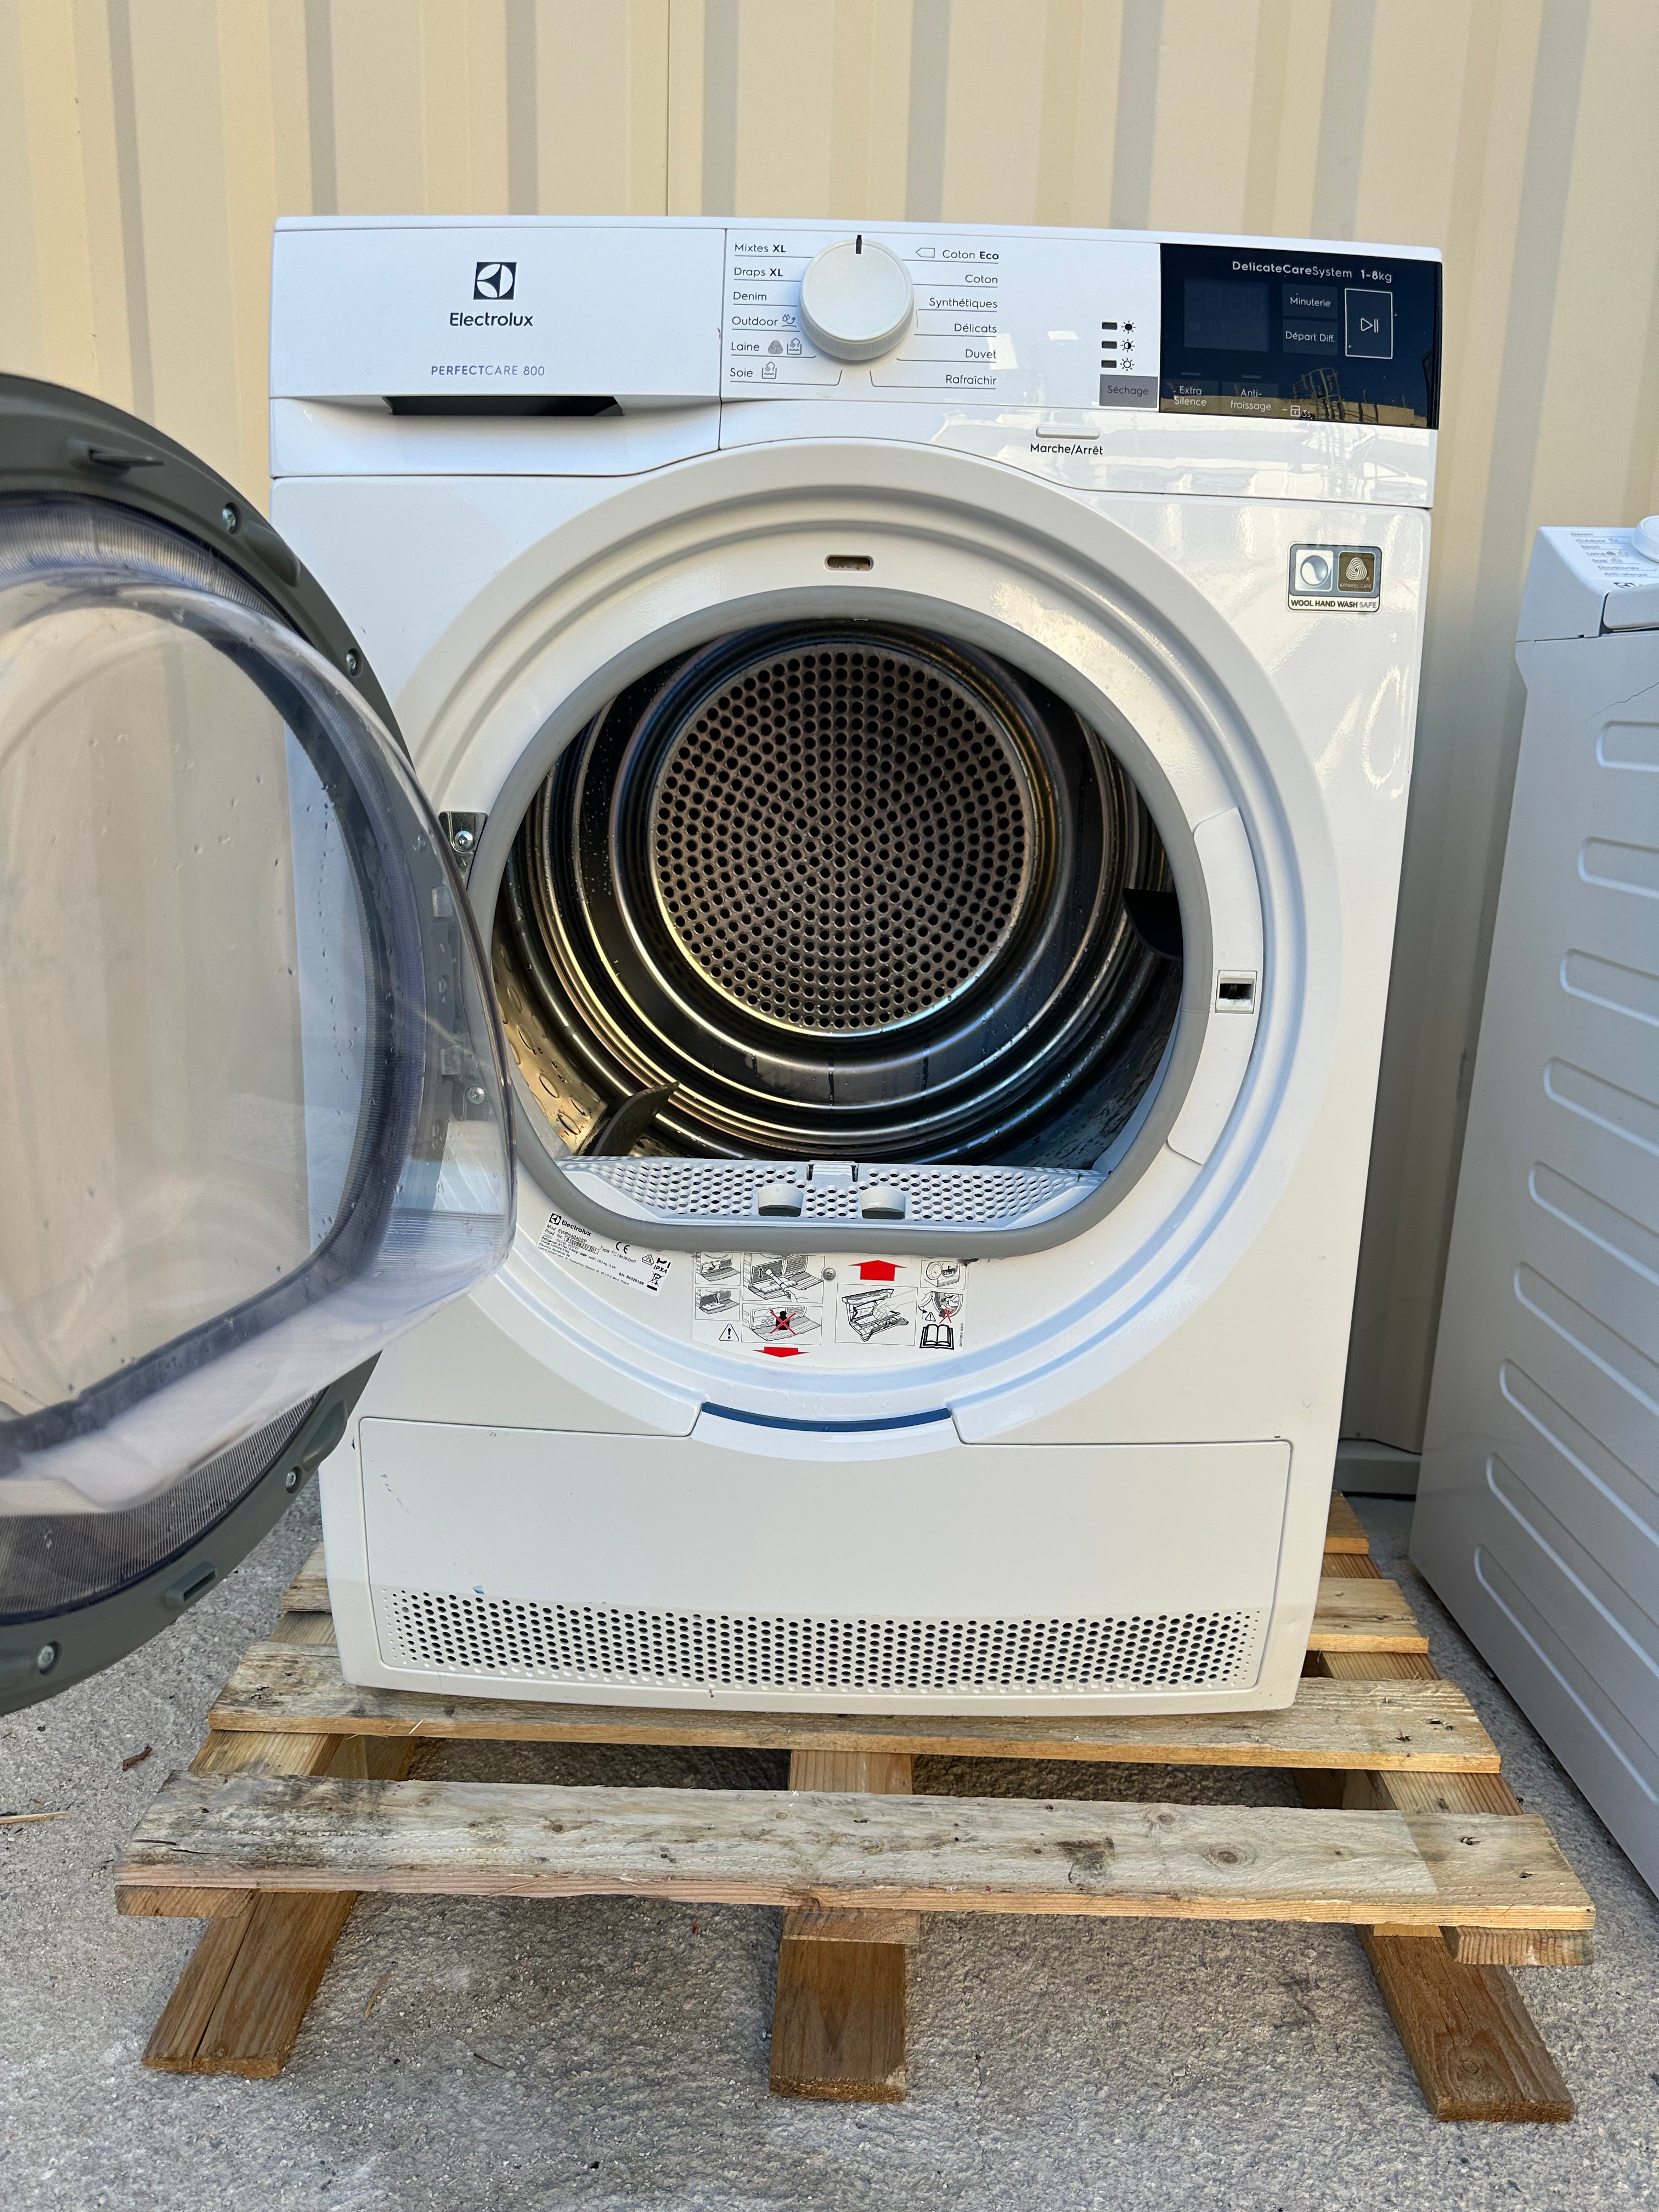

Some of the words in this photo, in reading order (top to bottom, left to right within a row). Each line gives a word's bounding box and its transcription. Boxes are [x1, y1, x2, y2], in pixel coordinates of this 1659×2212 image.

[734, 242, 769, 253] Mixtes
[772, 244, 786, 253] XL
[942, 250, 975, 259] Coton
[980, 251, 999, 260] Eco
[733, 267, 765, 278] Draps
[770, 268, 783, 276] XL
[1232, 261, 1352, 278] DelicateCareSystem
[1361, 270, 1392, 283] 1-8kg
[964, 274, 997, 284] Coton
[733, 291, 766, 301] Denim
[929, 297, 997, 309] Synthétiques
[1289, 296, 1331, 308] Minuterie
[450, 312, 533, 327] Electrolux
[731, 316, 778, 326] Outdoor
[953, 323, 997, 334] Délicats
[1285, 331, 1317, 343] Départ
[1319, 333, 1335, 343] Diff.
[731, 342, 759, 352] Laine
[964, 349, 996, 359] Duvet
[431, 365, 518, 375] PERFECTCARE
[523, 366, 545, 376] 800
[730, 368, 753, 377] Soie
[946, 374, 996, 385] Rafraîchir
[1107, 386, 1149, 397] Séchage
[1179, 386, 1203, 396] Extra
[1240, 388, 1262, 397] Anti-
[1174, 397, 1207, 407] Silence
[1231, 401, 1271, 412] froissage
[1030, 443, 1103, 455] Marche/Arrêt
[561, 1220, 592, 1236] Electrolux
[653, 1265, 667, 1273] IPX4
